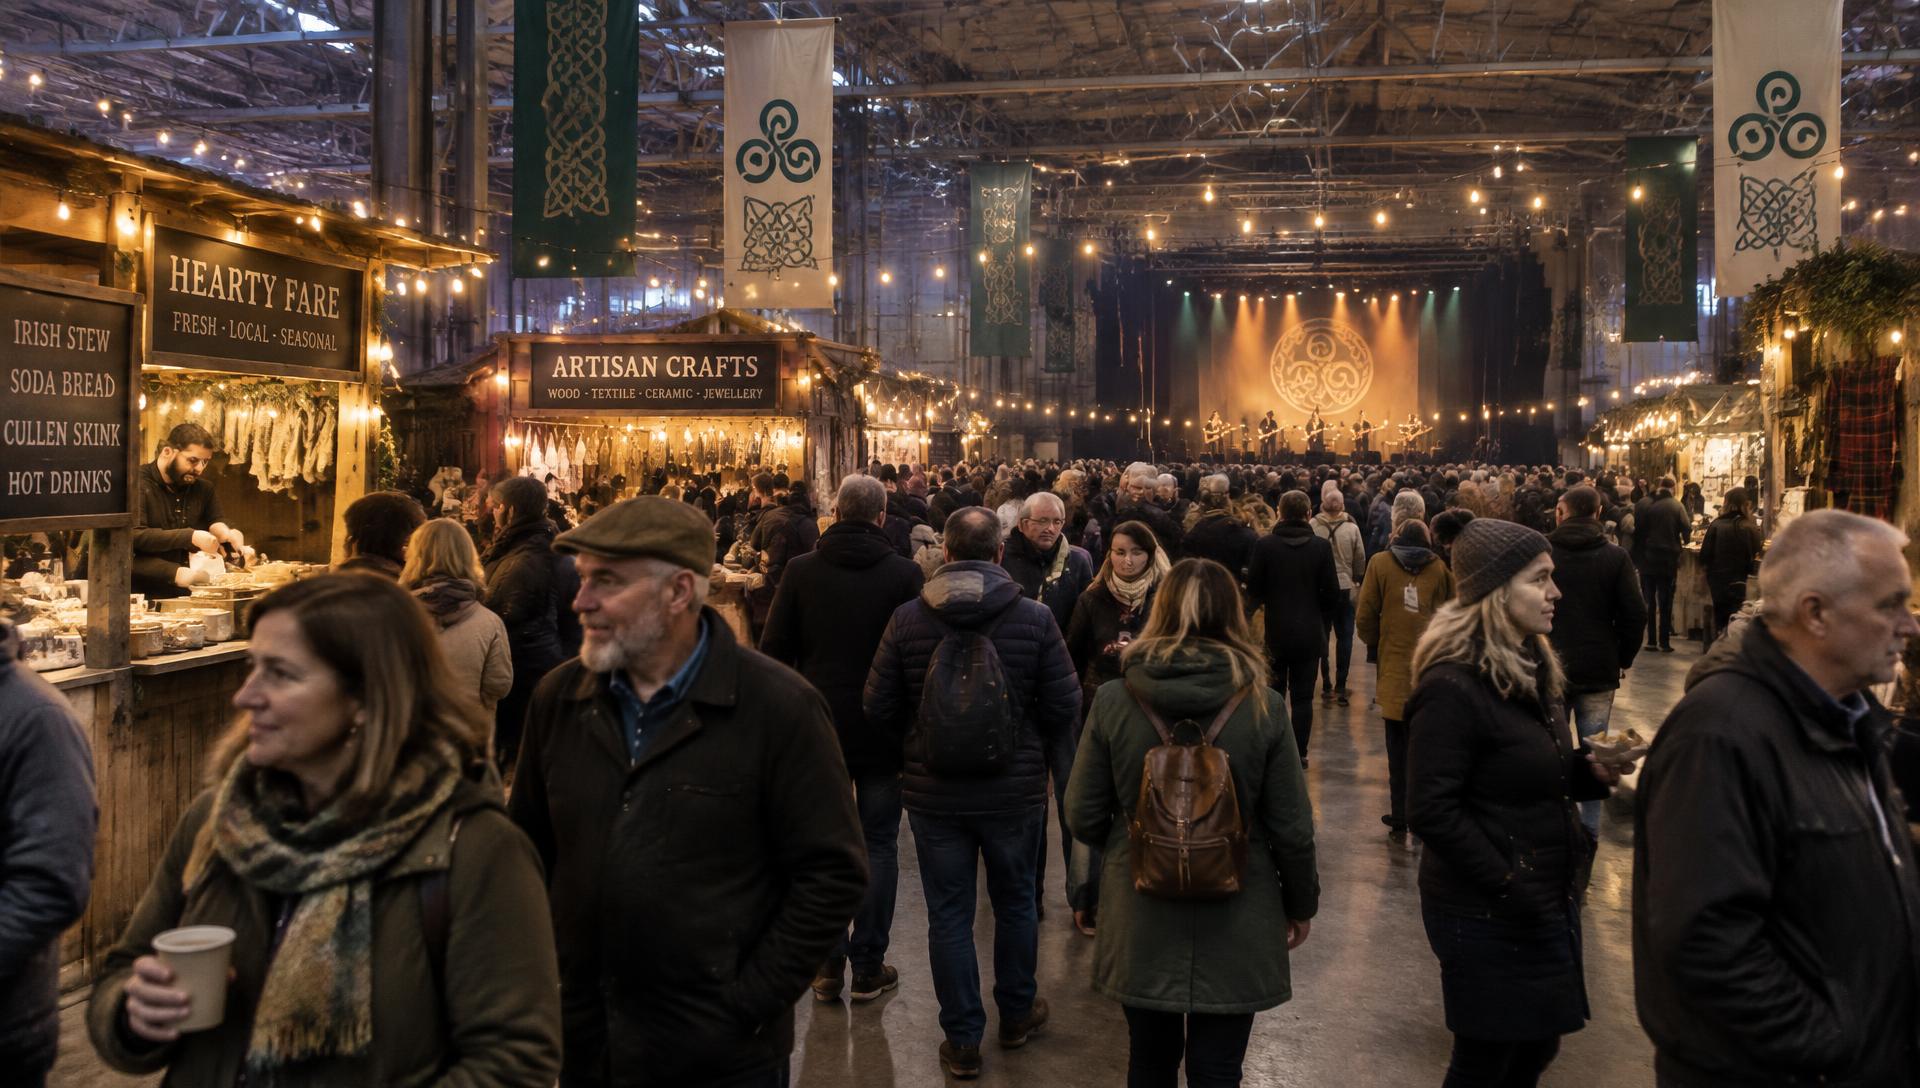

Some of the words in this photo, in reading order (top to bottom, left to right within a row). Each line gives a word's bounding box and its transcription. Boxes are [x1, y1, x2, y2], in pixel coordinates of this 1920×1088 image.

[169, 254, 277, 309] HEARTY
[284, 278, 340, 320] FARE
[14, 319, 61, 347] IRISH
[67, 326, 110, 352] STEW
[173, 312, 216, 335] FRESH
[230, 320, 269, 342] LOCAL
[281, 328, 337, 351] SEASONAL
[552, 356, 657, 377] ARTISAN
[666, 356, 757, 377] CRAFTS
[11, 369, 56, 395] SODA
[63, 372, 115, 397] BREAD
[547, 388, 581, 400] WOOD
[591, 388, 636, 400] TEXTILE
[644, 388, 694, 400] CERAMIC
[702, 388, 763, 400] JEWELLERY
[4, 420, 67, 445] CULLEN
[74, 422, 120, 446] SKINK
[8, 471, 44, 496] HOT
[51, 470, 111, 494] DRINKS
